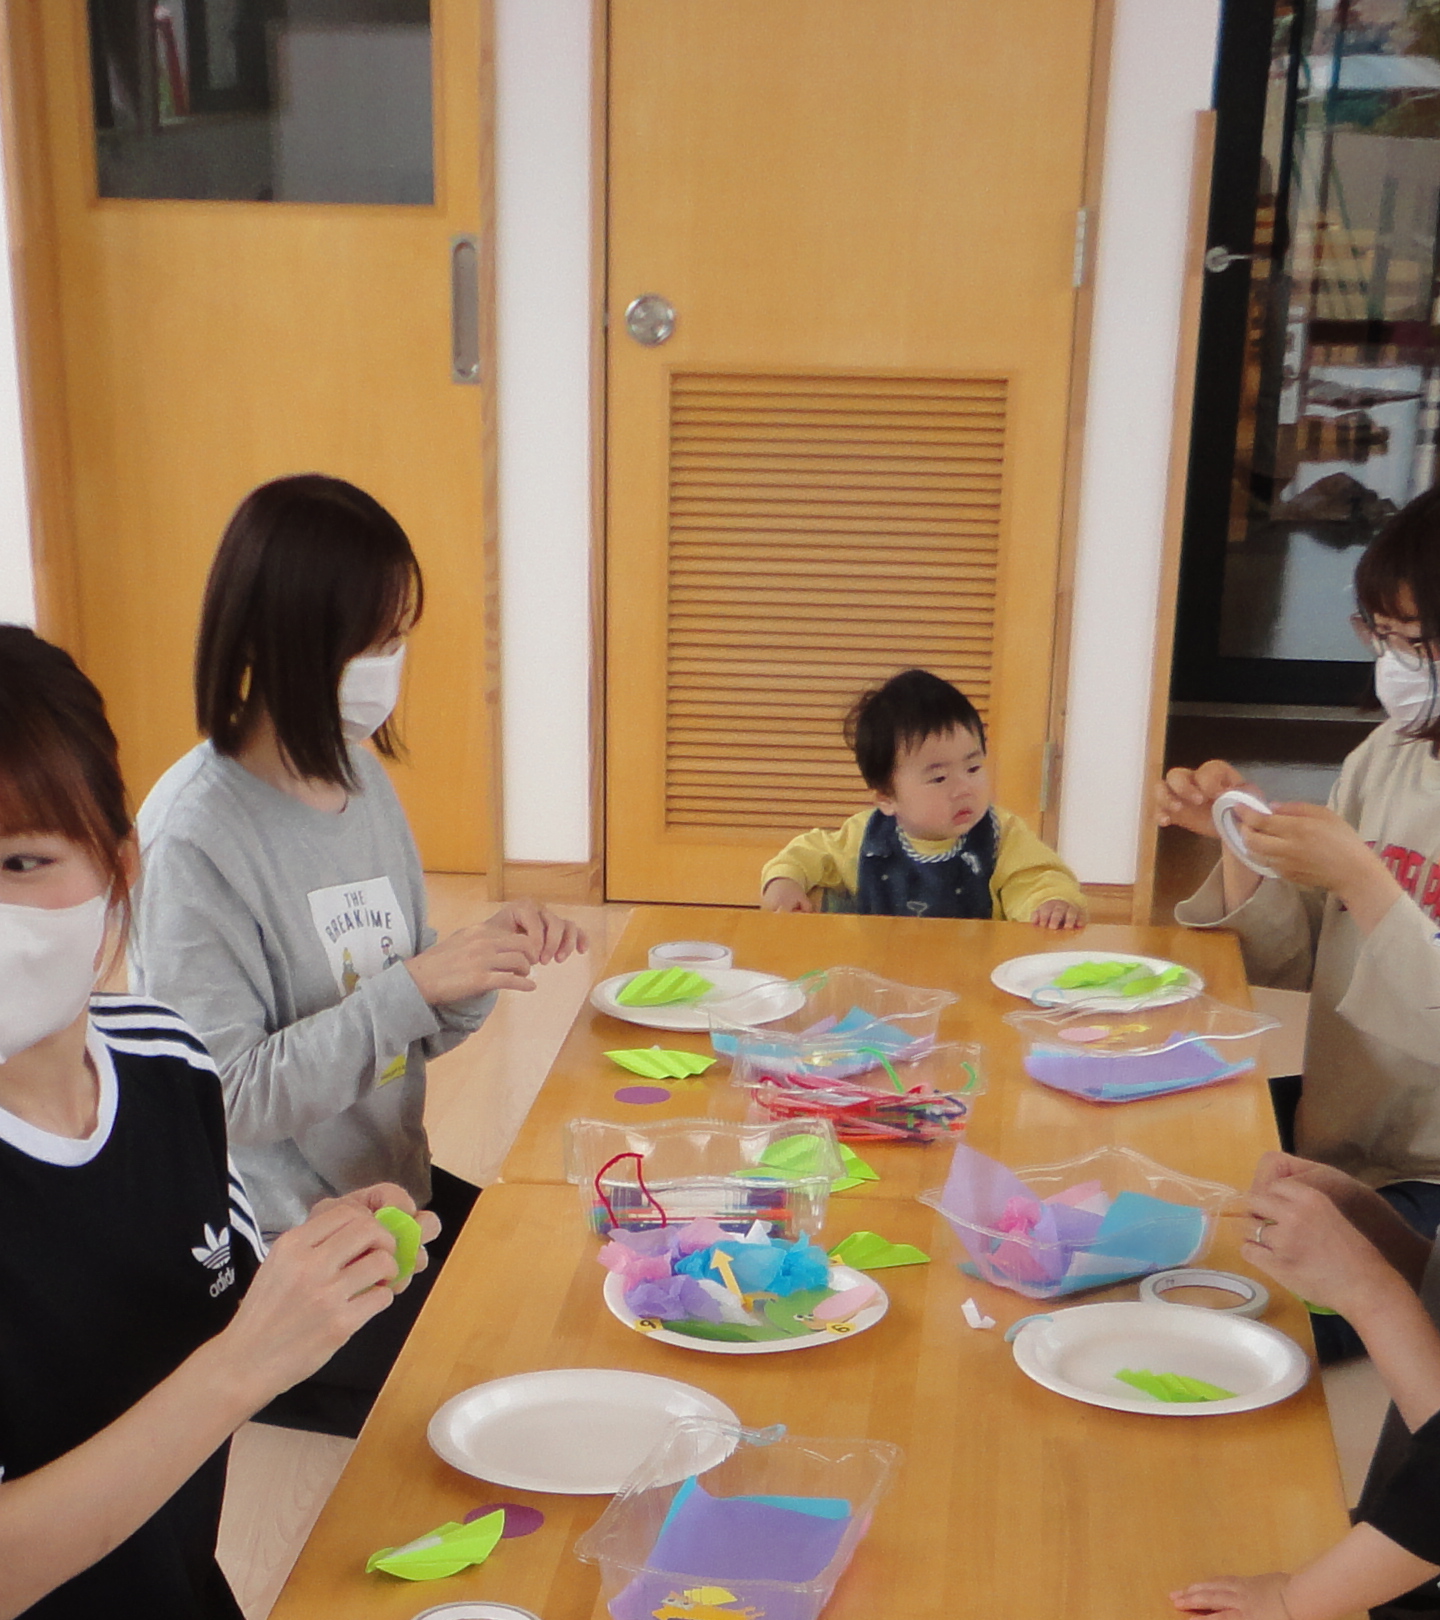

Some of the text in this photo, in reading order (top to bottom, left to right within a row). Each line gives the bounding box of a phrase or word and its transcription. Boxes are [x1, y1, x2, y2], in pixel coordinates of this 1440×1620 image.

[343, 889, 366, 909] THE
[325, 908, 364, 944] BREAK
[209, 1266, 236, 1299] adid
